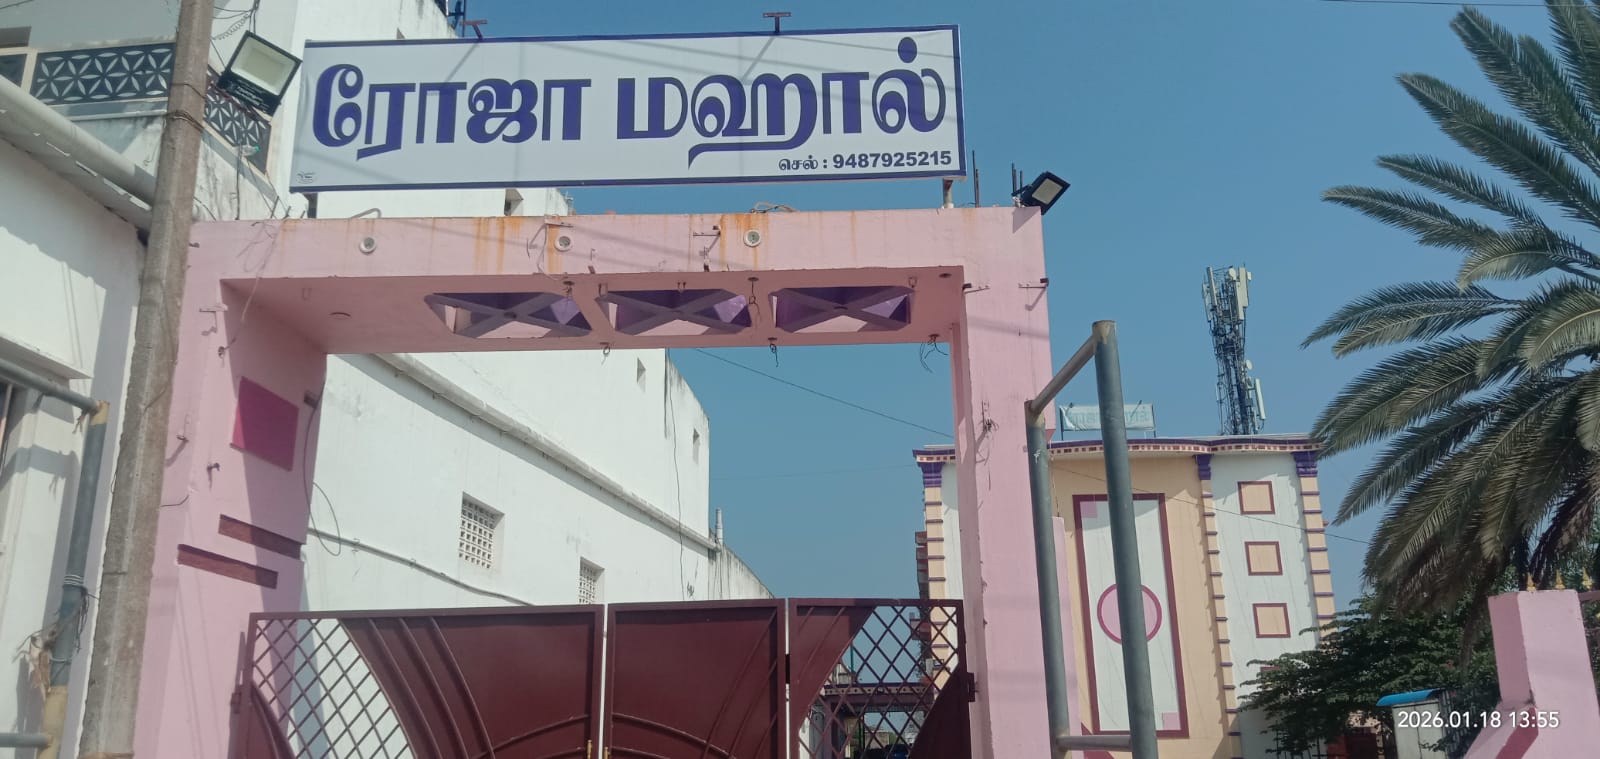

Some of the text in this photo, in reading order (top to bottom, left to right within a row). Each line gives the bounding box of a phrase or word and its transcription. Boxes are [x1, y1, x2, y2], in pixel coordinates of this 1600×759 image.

[312, 37, 947, 169] ரோஜா மஹால்
[778, 156, 819, 171] செல்
[832, 150, 952, 169] 9487925215
